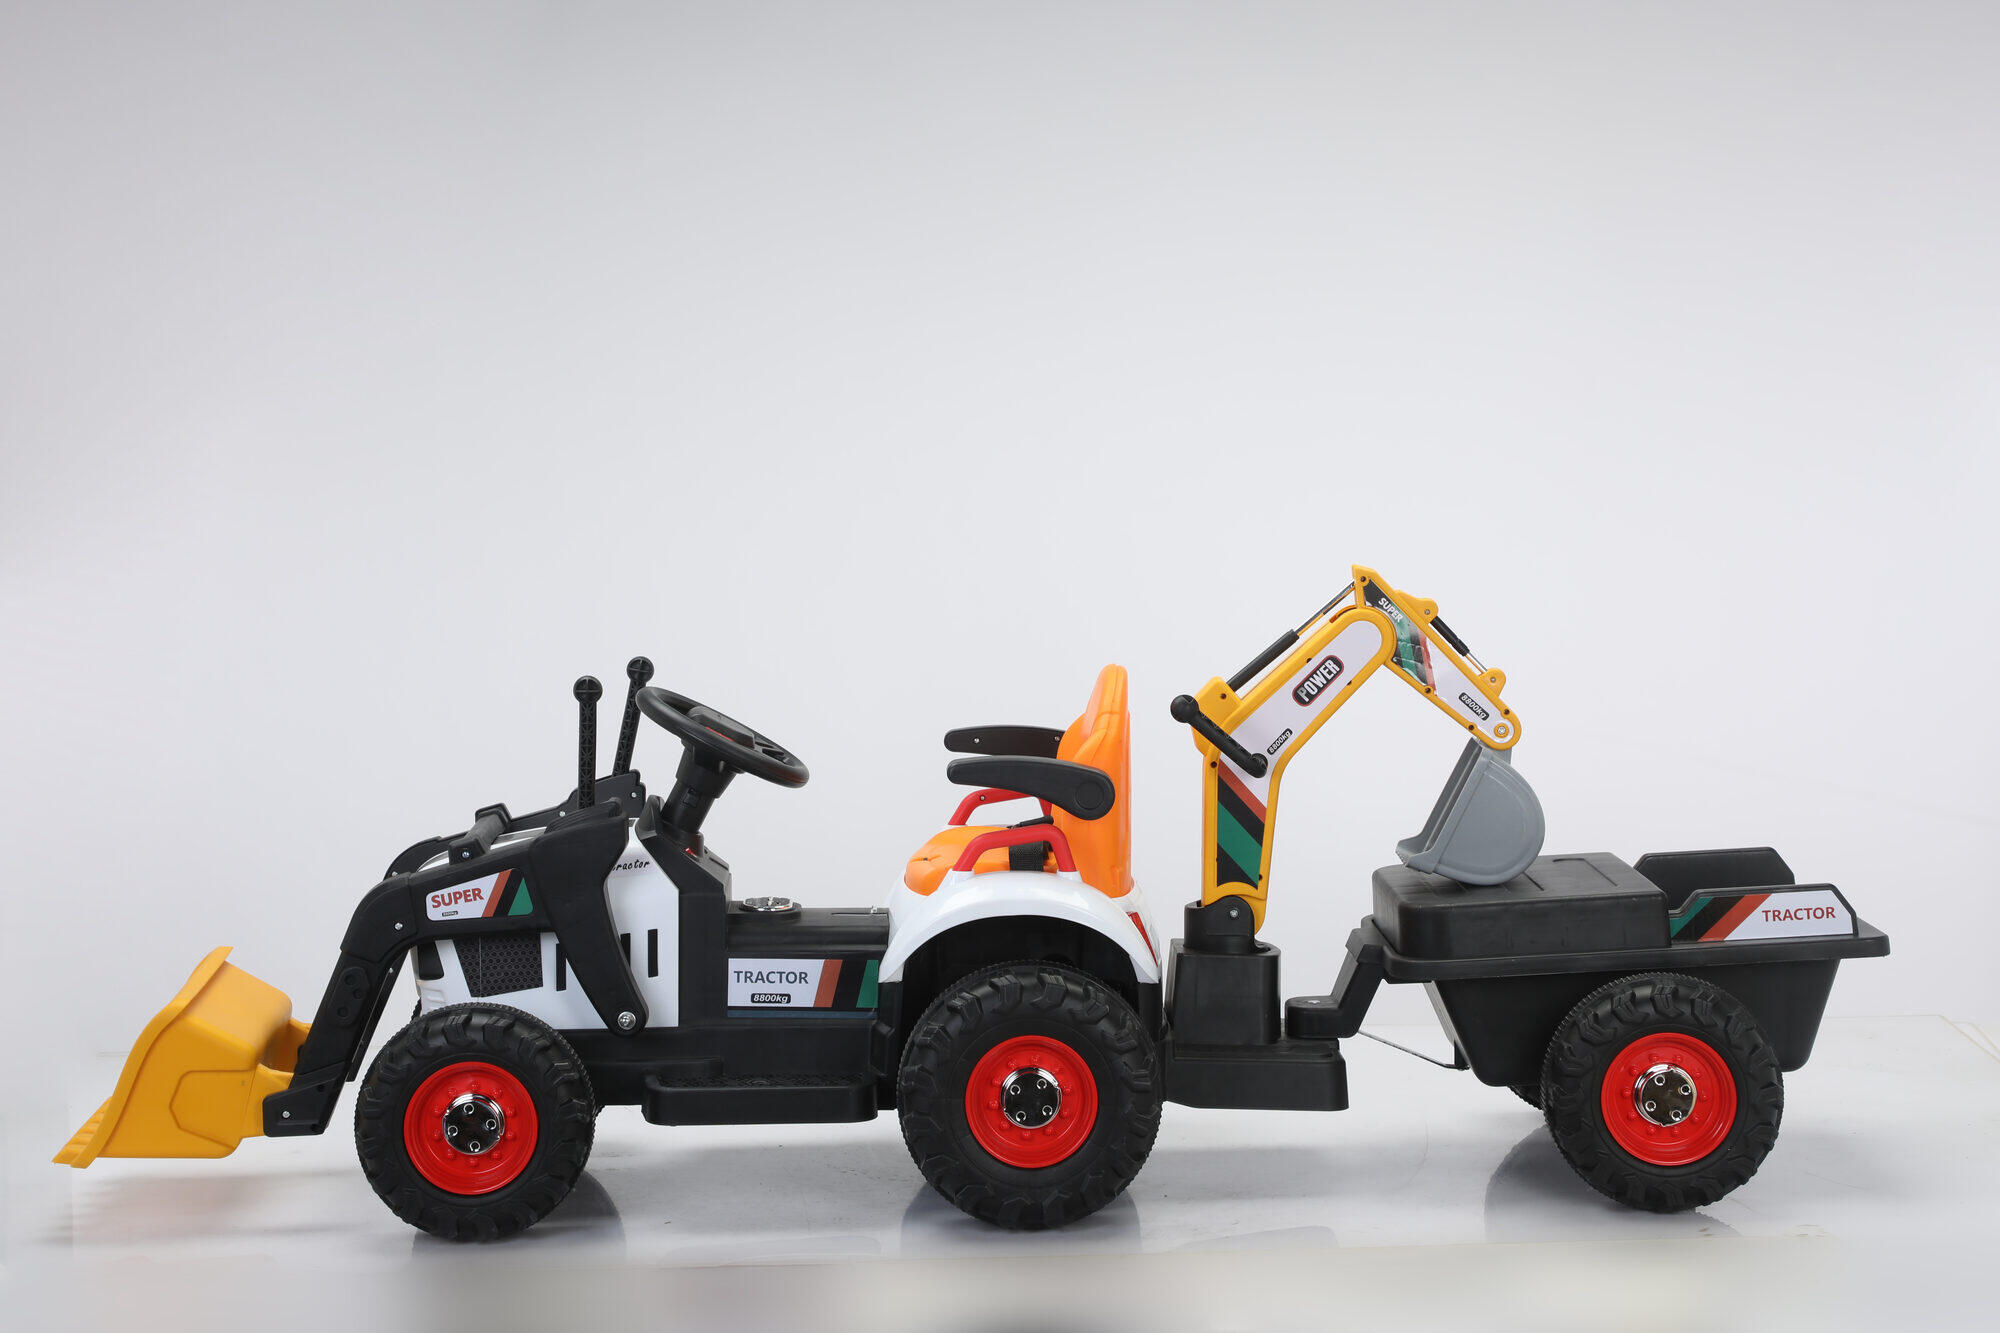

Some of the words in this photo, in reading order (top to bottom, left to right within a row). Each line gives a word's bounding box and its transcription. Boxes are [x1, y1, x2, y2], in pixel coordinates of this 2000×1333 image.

[1378, 597, 1404, 623] SUPER
[1296, 659, 1340, 703] POWER
[1461, 694, 1487, 719] 8800kg
[1268, 730, 1292, 754] 8800kg
[431, 888, 484, 908] SUPER
[1762, 906, 1836, 922] TRACTOR
[733, 971, 809, 985] TRACTOR
[753, 994, 788, 1003] 8800kg
